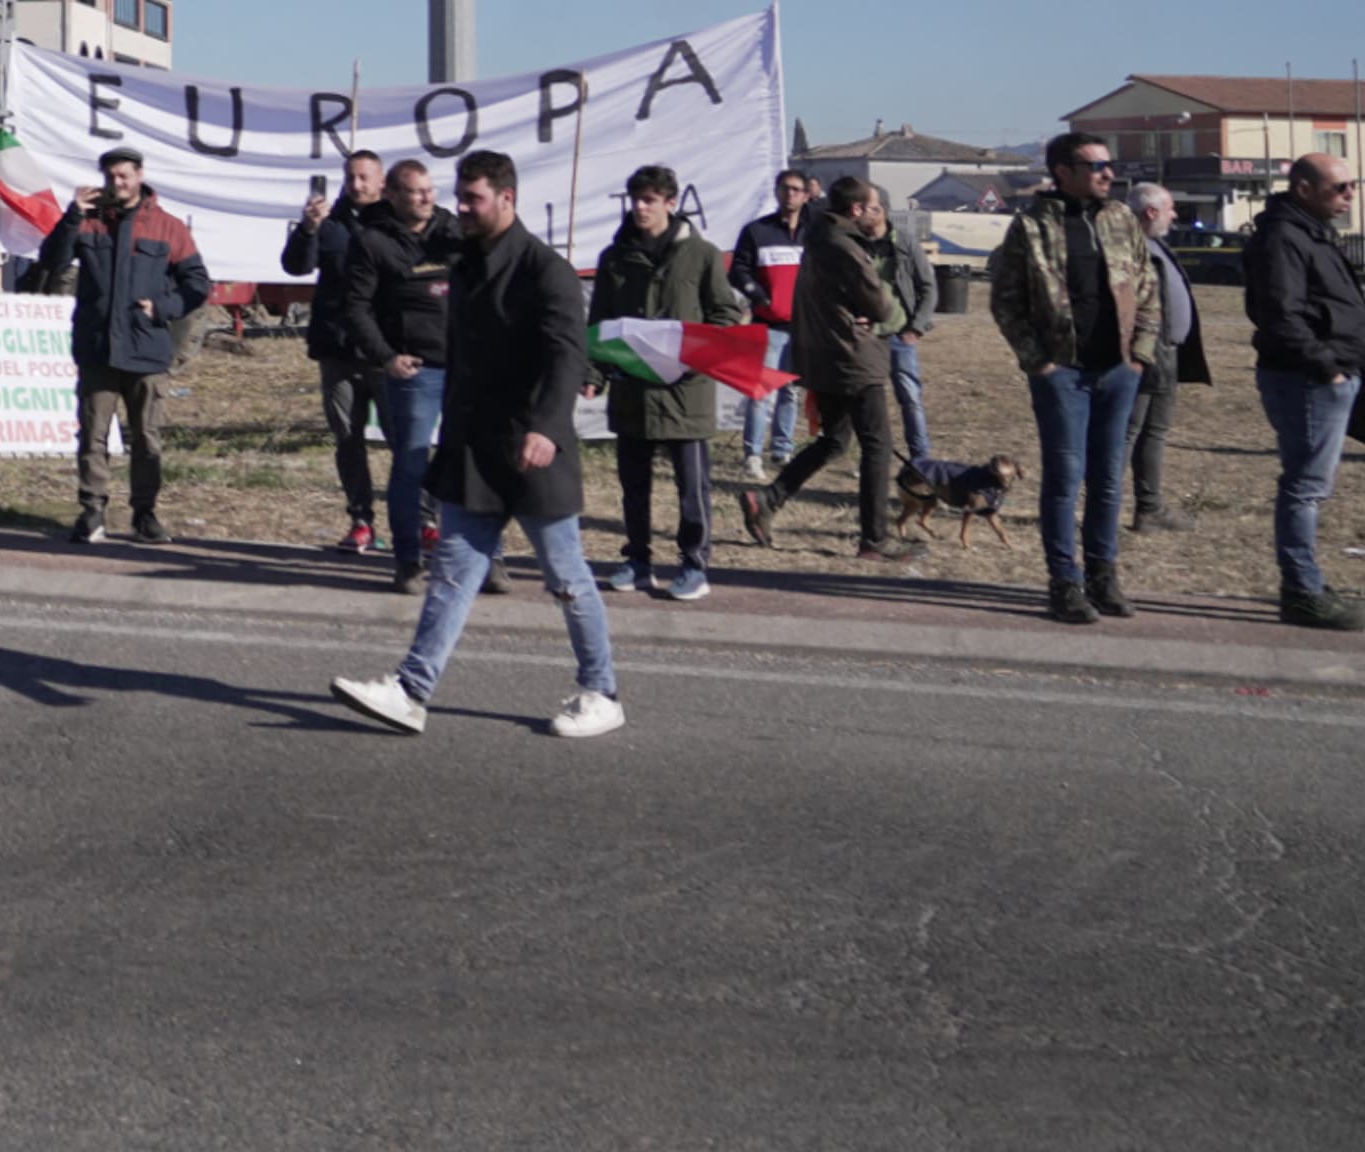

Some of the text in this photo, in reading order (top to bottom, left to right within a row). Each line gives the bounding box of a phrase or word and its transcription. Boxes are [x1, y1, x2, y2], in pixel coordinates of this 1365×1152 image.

[88, 39, 724, 159] EUROPA
[1221, 159, 1254, 175] BAR
[14, 303, 64, 321] STATE
[27, 361, 79, 378] POCO
